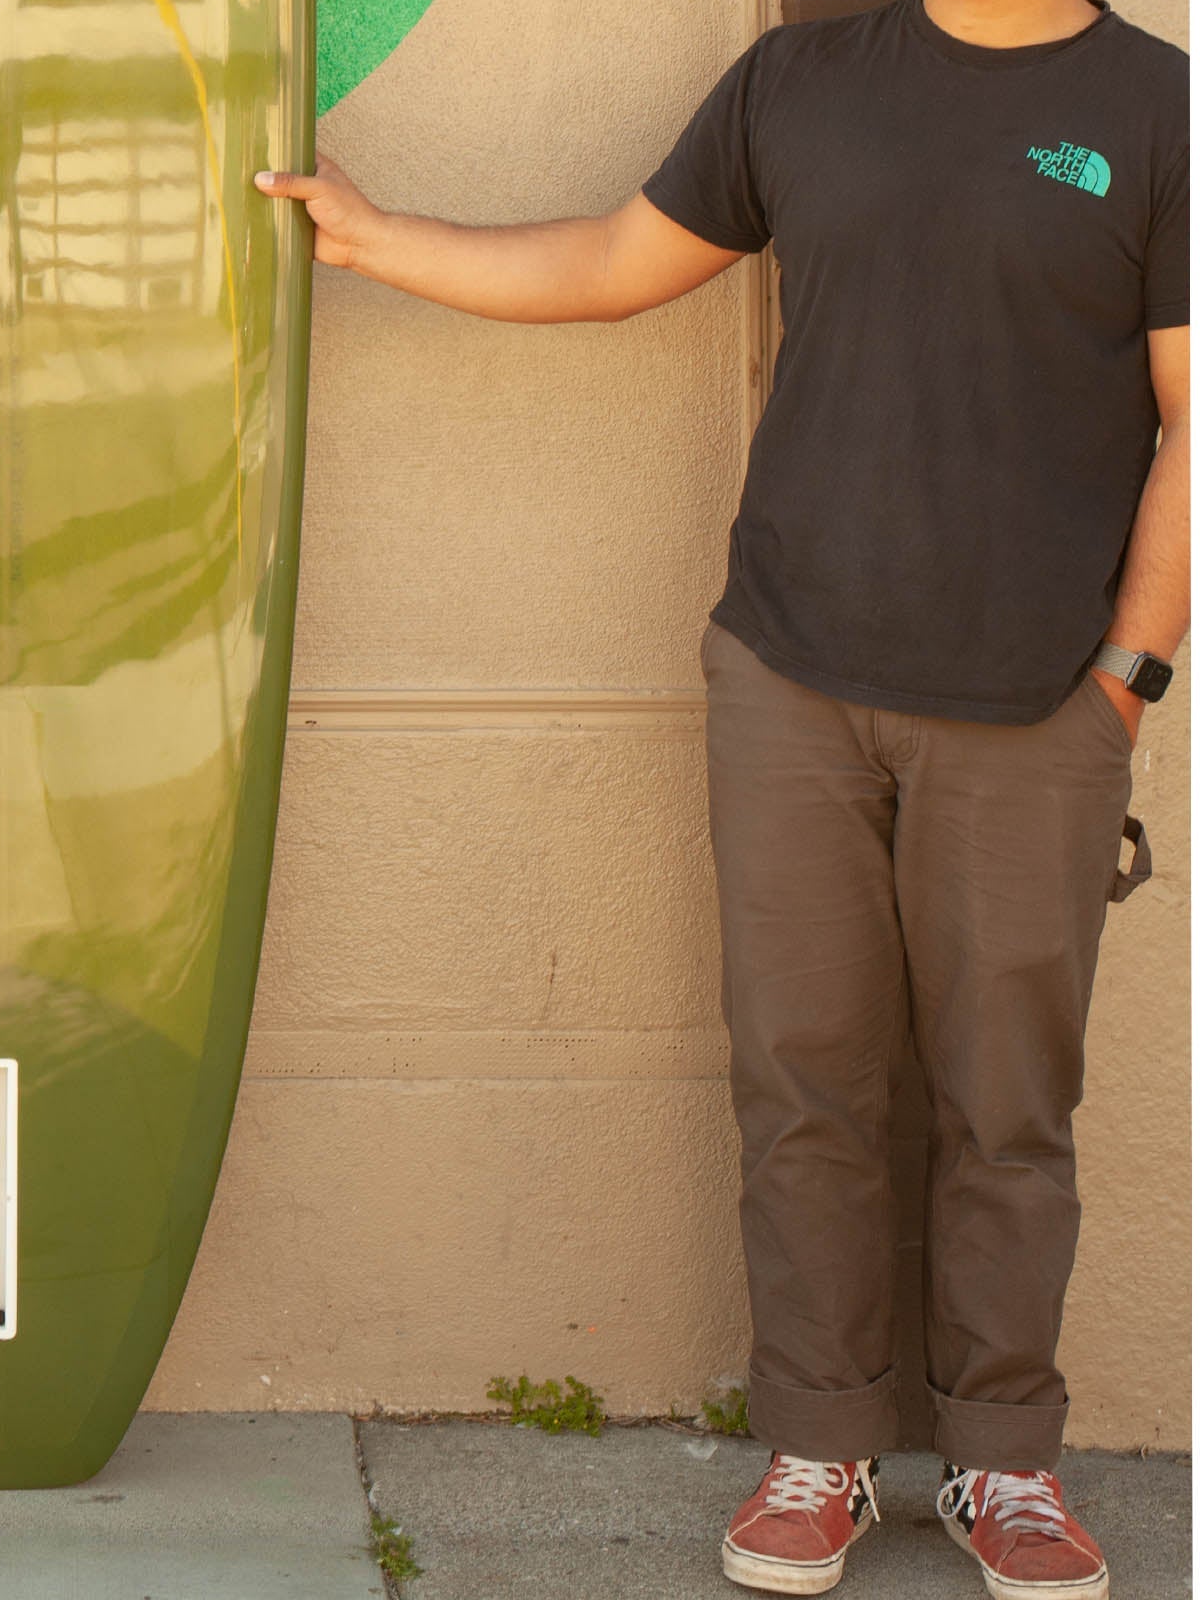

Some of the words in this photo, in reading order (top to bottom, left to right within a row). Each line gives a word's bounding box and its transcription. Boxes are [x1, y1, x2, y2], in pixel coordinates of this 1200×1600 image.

[1026, 146, 1086, 173] NORTH
[1060, 141, 1090, 160] THE
[1037, 161, 1079, 185] FACE
